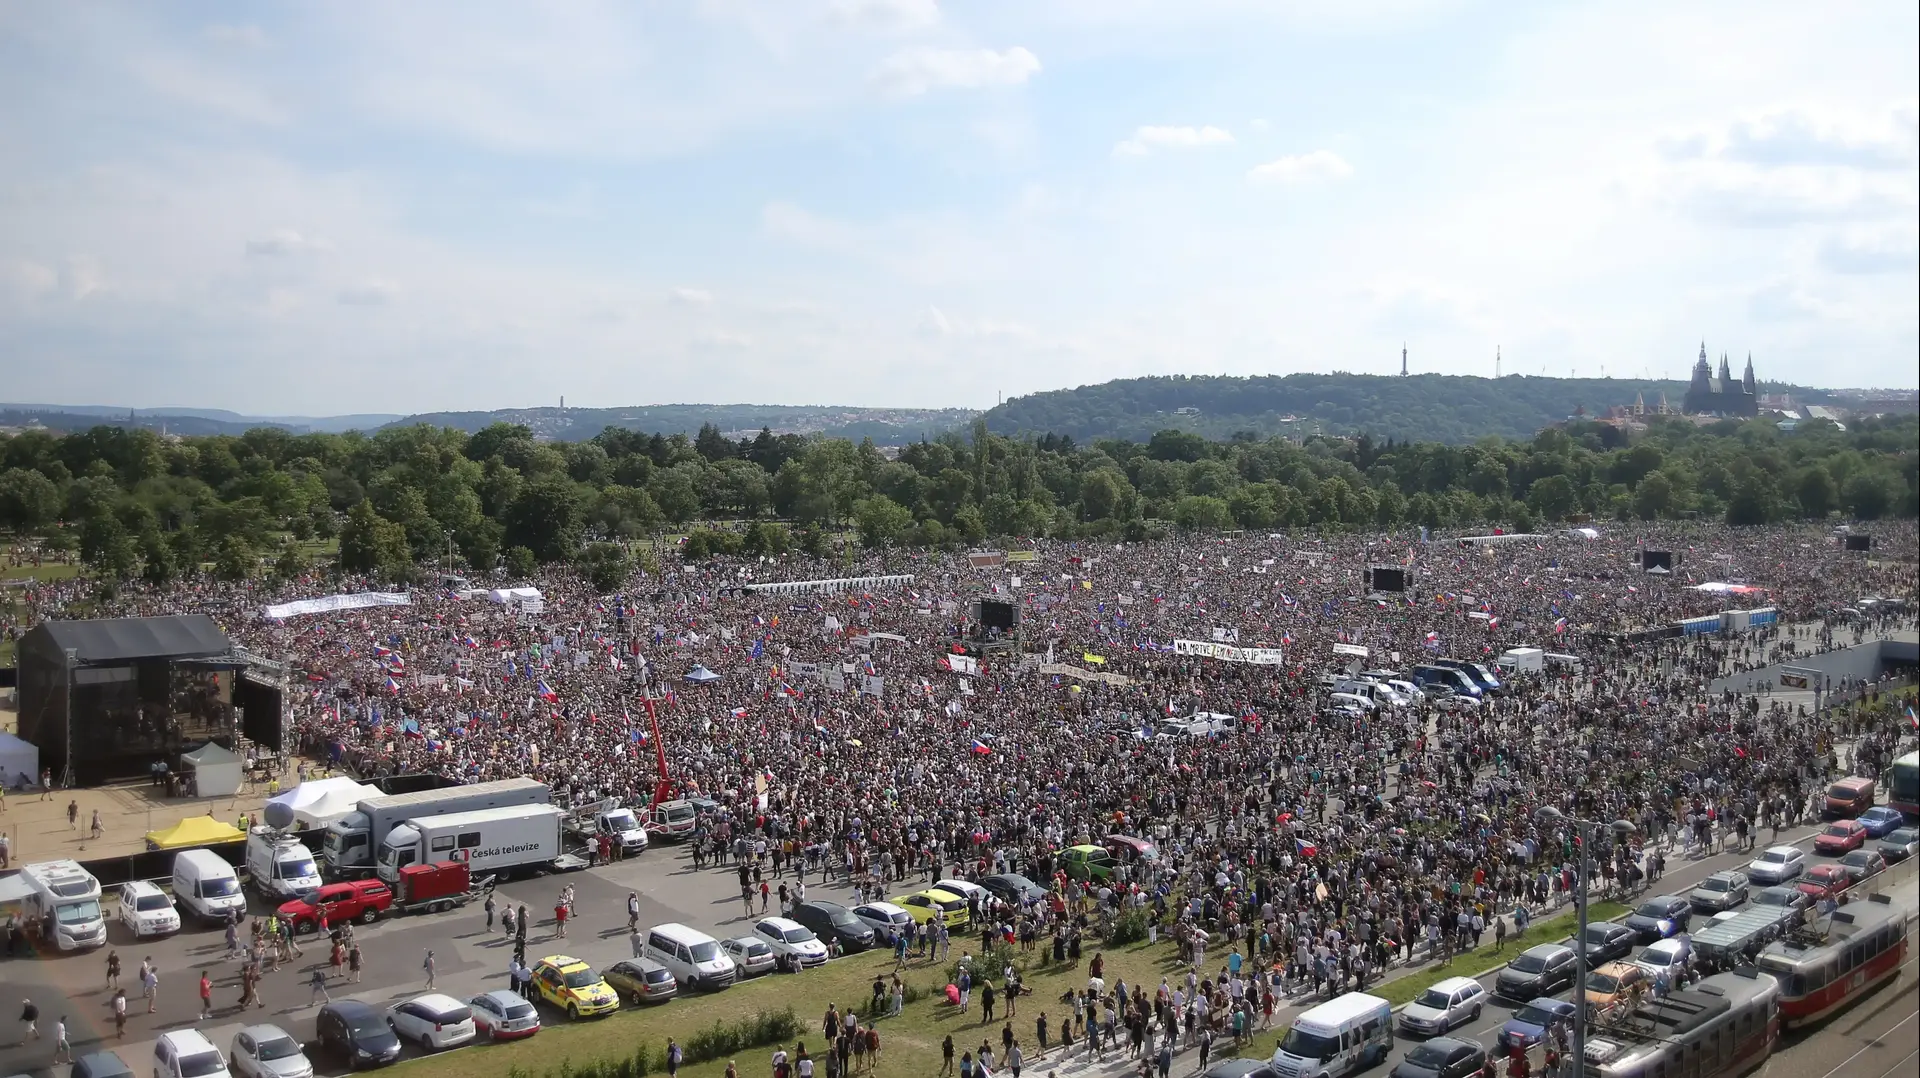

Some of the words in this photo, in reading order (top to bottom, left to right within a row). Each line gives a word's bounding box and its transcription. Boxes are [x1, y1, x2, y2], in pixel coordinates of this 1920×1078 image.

[1177, 642, 1188, 652] NA
[471, 848, 500, 859] Česká
[502, 842, 540, 854] televize
